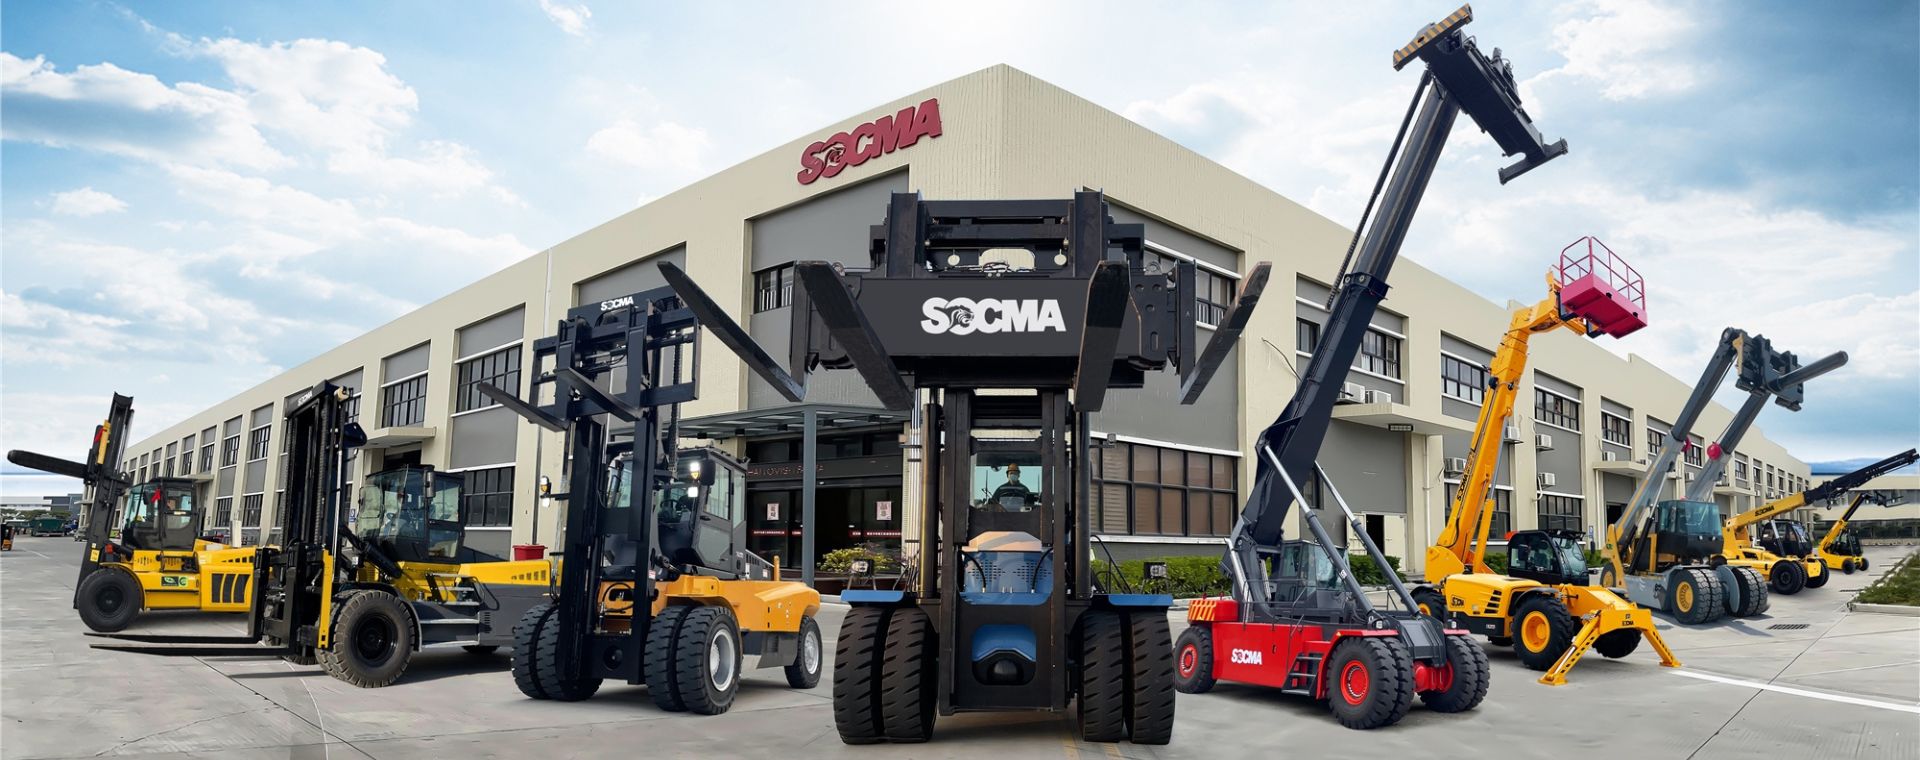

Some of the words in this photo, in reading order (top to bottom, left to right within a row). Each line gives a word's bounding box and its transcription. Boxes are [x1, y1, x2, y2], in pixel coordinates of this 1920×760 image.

[798, 98, 942, 185] SOCMA
[600, 296, 634, 311] SOCMA
[921, 297, 1067, 335] SOCMA
[1231, 648, 1262, 665] SOCMA
